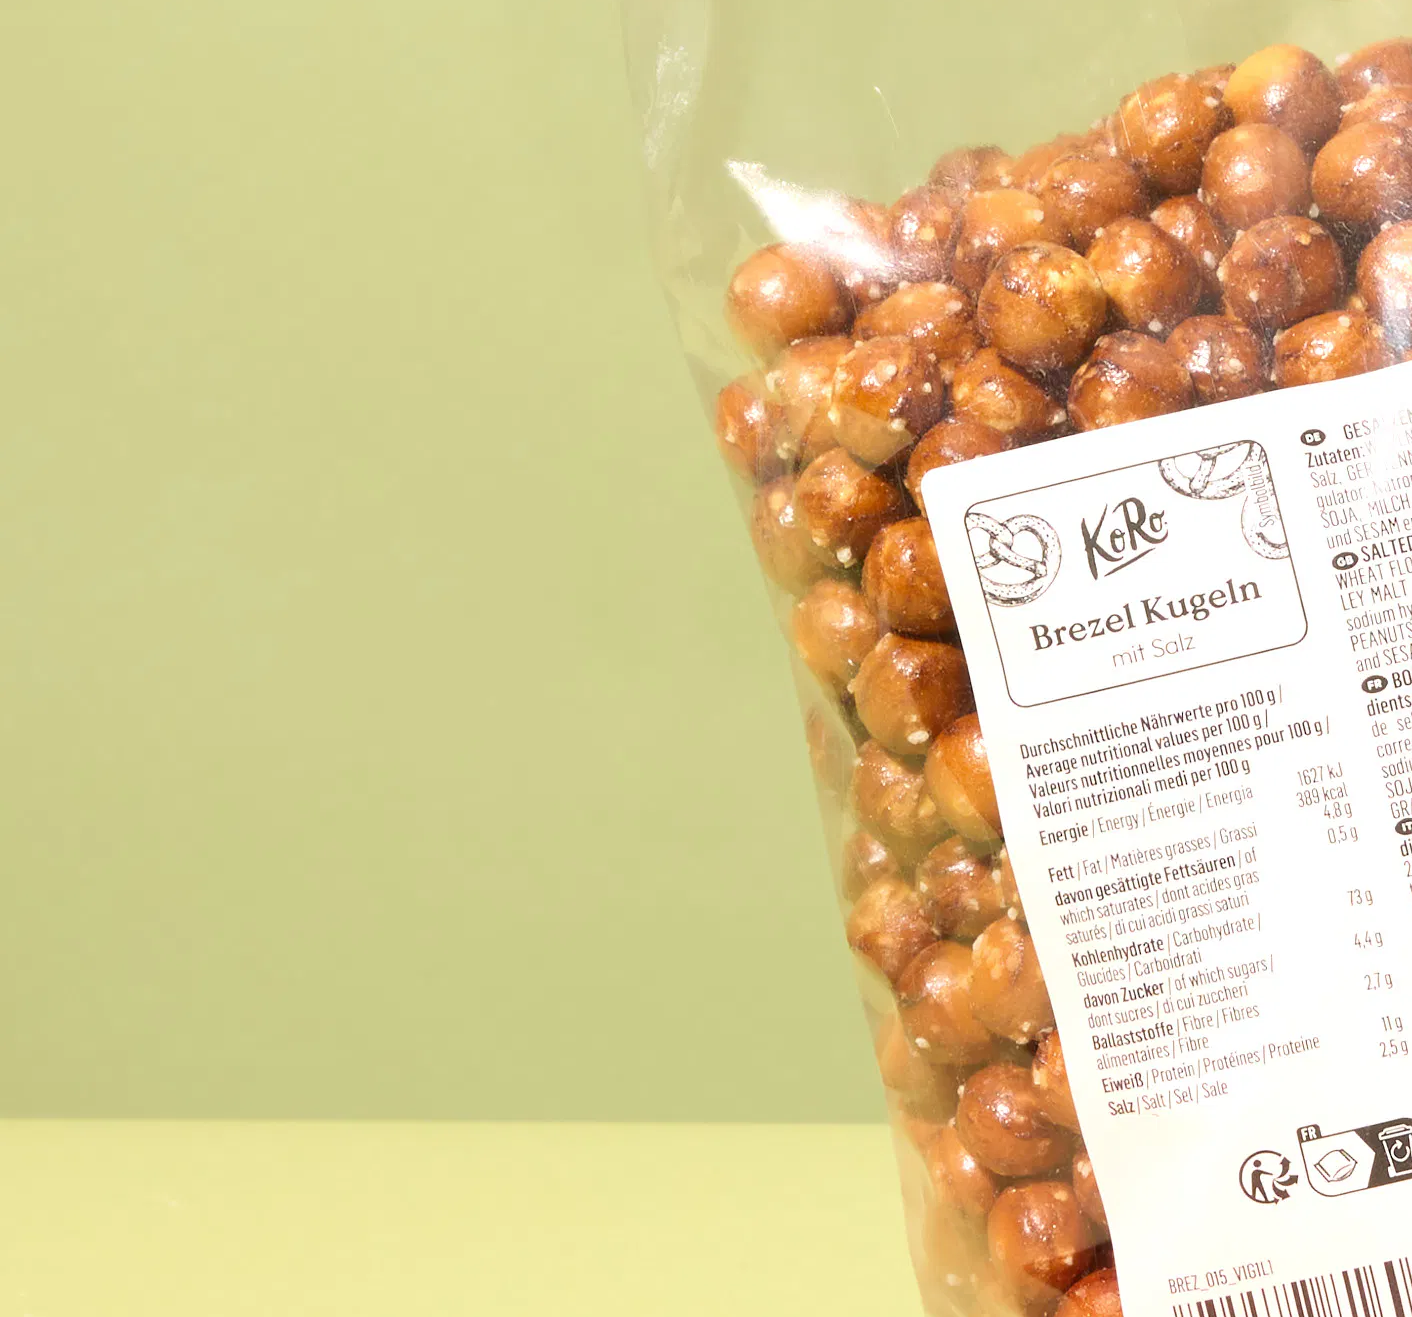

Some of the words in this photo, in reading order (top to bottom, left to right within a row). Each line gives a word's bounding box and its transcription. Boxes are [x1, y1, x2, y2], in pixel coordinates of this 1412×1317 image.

[1245, 464, 1275, 528] Symbolbild
[1080, 497, 1169, 581] KoRo
[1028, 603, 1137, 651] Brezel
[1140, 578, 1263, 625] Kugeln
[1112, 644, 1145, 668] mit
[1151, 633, 1196, 658] Salz
[1355, 651, 1381, 673] and
[1019, 721, 1139, 760] Durchschnittliche
[1140, 705, 1213, 732] Nährwerte
[1215, 699, 1239, 718] pro
[1240, 689, 1265, 709] 100
[1266, 690, 1276, 706] g
[1026, 757, 1078, 779] Average
[1080, 736, 1153, 768] nutritional
[1154, 729, 1200, 750] values
[1201, 723, 1223, 743] per
[1225, 713, 1251, 733] 100
[1252, 714, 1262, 731] g
[1028, 778, 1079, 799] Valeurs
[1080, 754, 1181, 788] nutritionnelles
[1183, 737, 1252, 765] moyennes
[1254, 729, 1285, 751] pour
[1287, 720, 1312, 739] 100
[1313, 721, 1323, 737] g
[1033, 796, 1073, 819] Valori
[1074, 778, 1152, 811] nutrizionali
[1154, 769, 1188, 792] medi
[1190, 768, 1212, 787] per
[1214, 758, 1239, 778] 100
[1241, 759, 1251, 776] g
[1039, 822, 1089, 846] Energie
[1097, 813, 1139, 834] Energy
[1147, 800, 1196, 822] Énergie
[1205, 785, 1254, 809] Energia
[1047, 865, 1075, 883] Fett
[1082, 859, 1103, 876] Fat
[1110, 847, 1164, 870] Matières
[1164, 836, 1211, 861] grasses
[1219, 821, 1258, 845] Grassi
[1071, 938, 1165, 968] Kohlenhydrate
[1172, 917, 1255, 948] Carbohydrate
[1101, 1072, 1144, 1094] Eiweiß
[1150, 1062, 1196, 1084] Protein
[1202, 1050, 1261, 1073] Protéines
[1268, 1036, 1320, 1059] Proteine
[1107, 1099, 1136, 1116] Salz
[1141, 1092, 1167, 1111] Salt
[1173, 1086, 1194, 1105] Sel
[1201, 1080, 1229, 1099] Sale
[1299, 1125, 1320, 1142] FR
